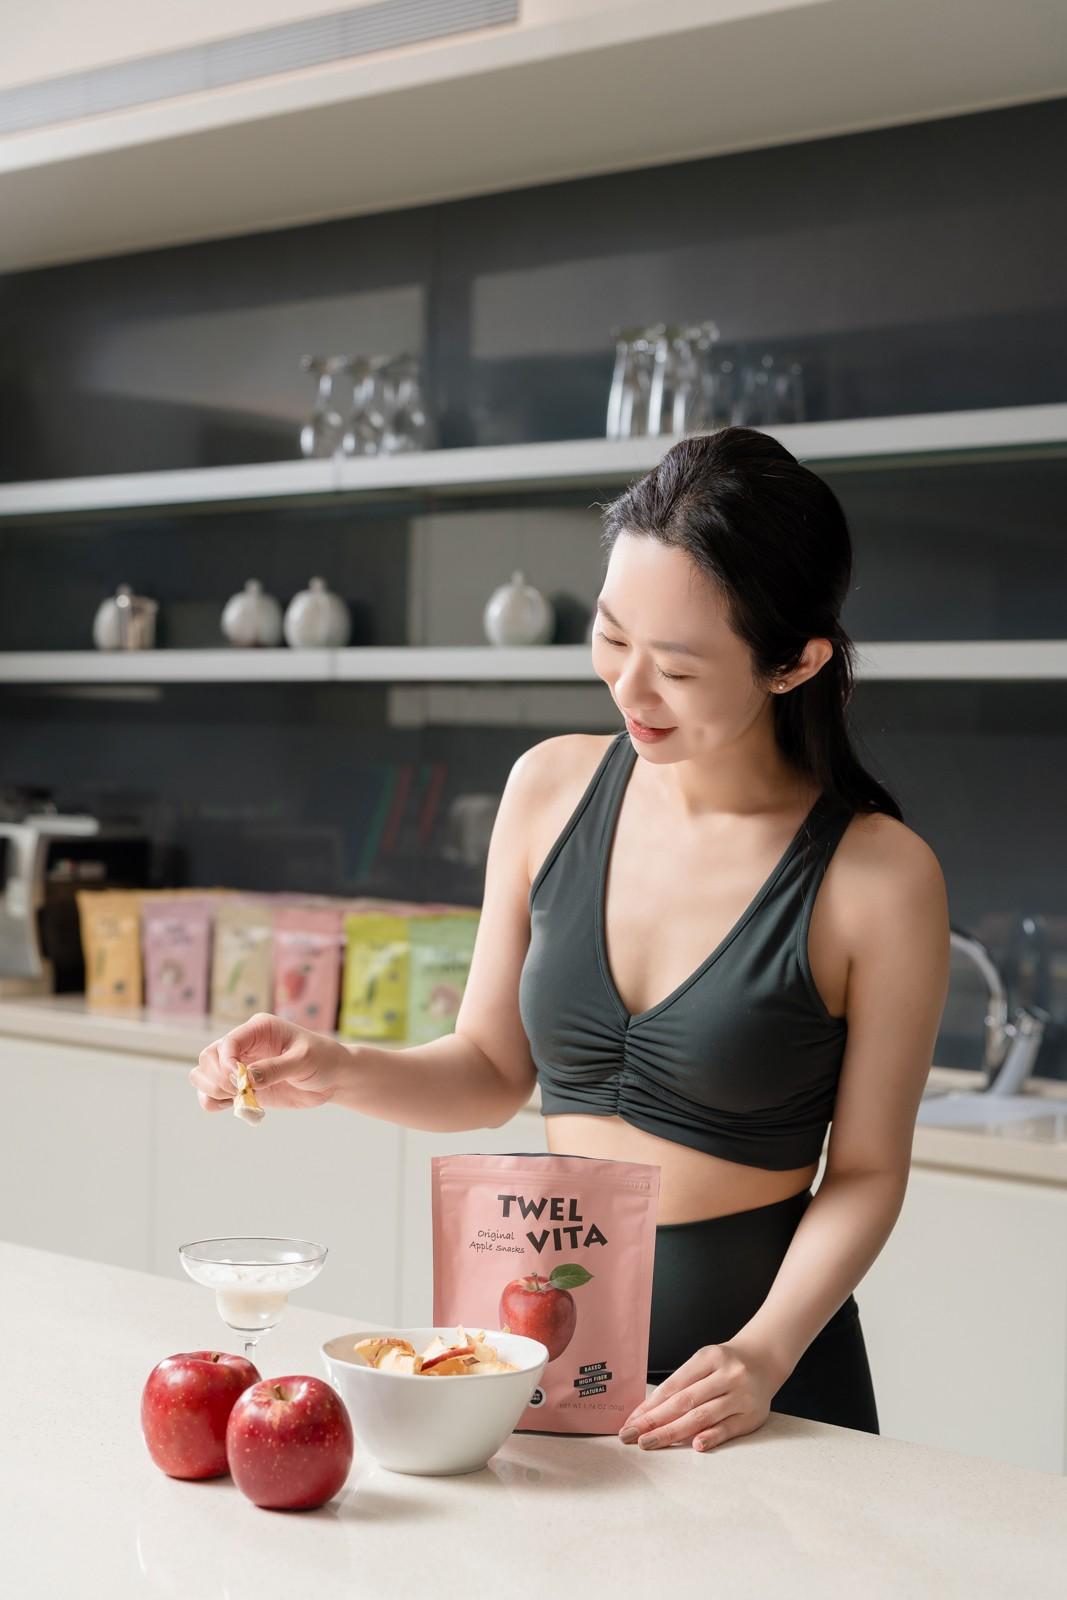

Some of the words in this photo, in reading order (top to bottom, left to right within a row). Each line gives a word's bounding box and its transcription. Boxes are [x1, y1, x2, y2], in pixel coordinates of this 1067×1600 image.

[497, 1194, 583, 1222] TWEL
[477, 1229, 515, 1242] Original
[526, 1223, 608, 1254] VITA
[469, 1241, 493, 1253] Apple
[584, 1364, 602, 1372] BAKED
[578, 1377, 593, 1385] HIGH
[593, 1374, 608, 1382] FIBER
[581, 1386, 605, 1396] NATURAL
